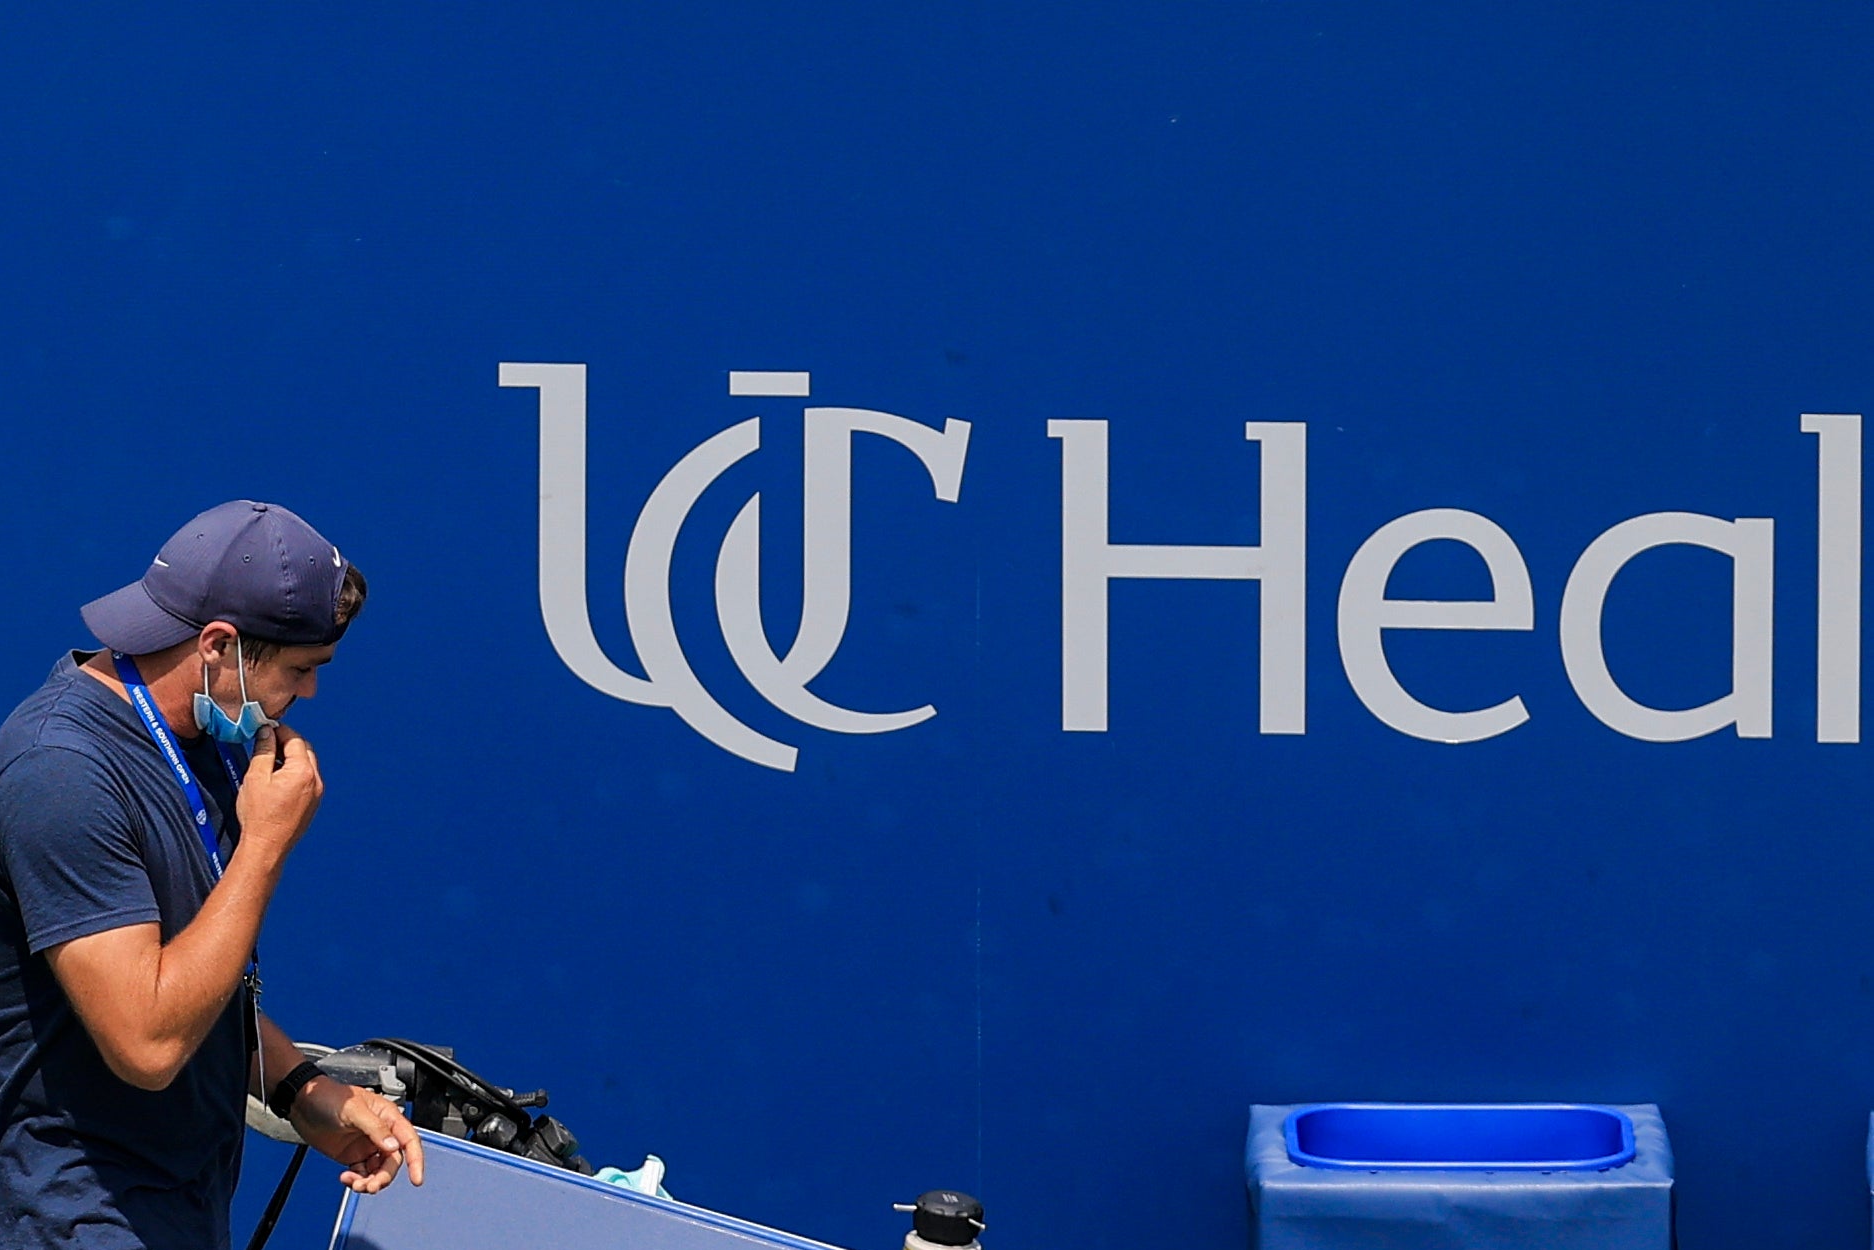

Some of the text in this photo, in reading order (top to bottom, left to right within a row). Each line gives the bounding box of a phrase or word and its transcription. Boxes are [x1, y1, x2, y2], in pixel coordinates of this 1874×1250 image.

[1046, 412, 1863, 745] Heal
[132, 685, 190, 785] WESTERN & SOUTHERN OPEN
